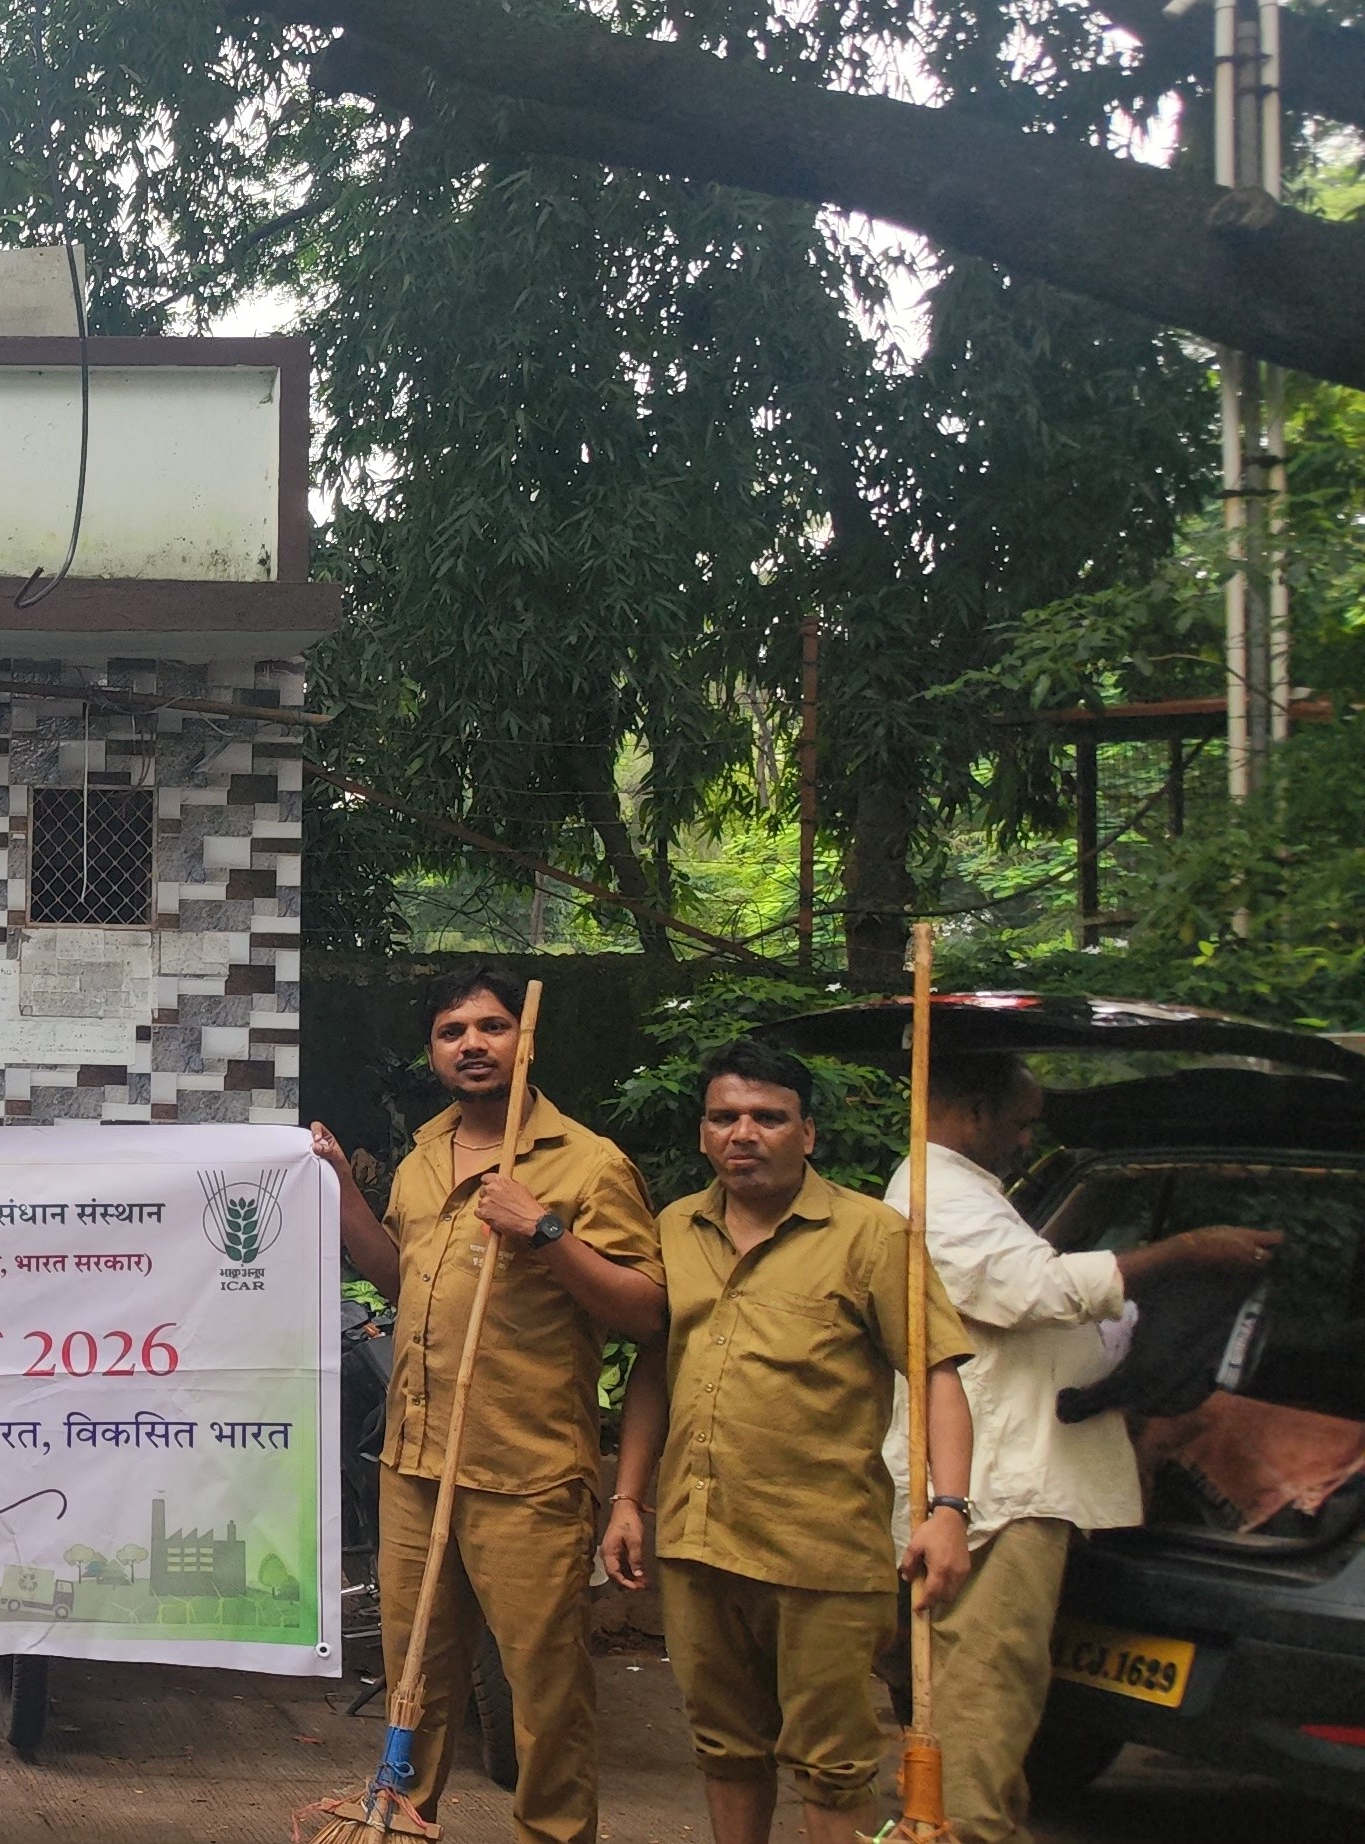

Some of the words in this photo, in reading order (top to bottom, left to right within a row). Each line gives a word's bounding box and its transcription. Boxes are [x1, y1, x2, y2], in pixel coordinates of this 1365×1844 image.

[75, 1198, 166, 1226] संस्थान
[14, 1254, 69, 1274] भारत
[73, 1253, 153, 1277] सरकार)
[220, 1281, 265, 1291] ICAR
[22, 1322, 179, 1378] 2026
[63, 1410, 198, 1449] विकसित
[209, 1421, 293, 1450] भारत
